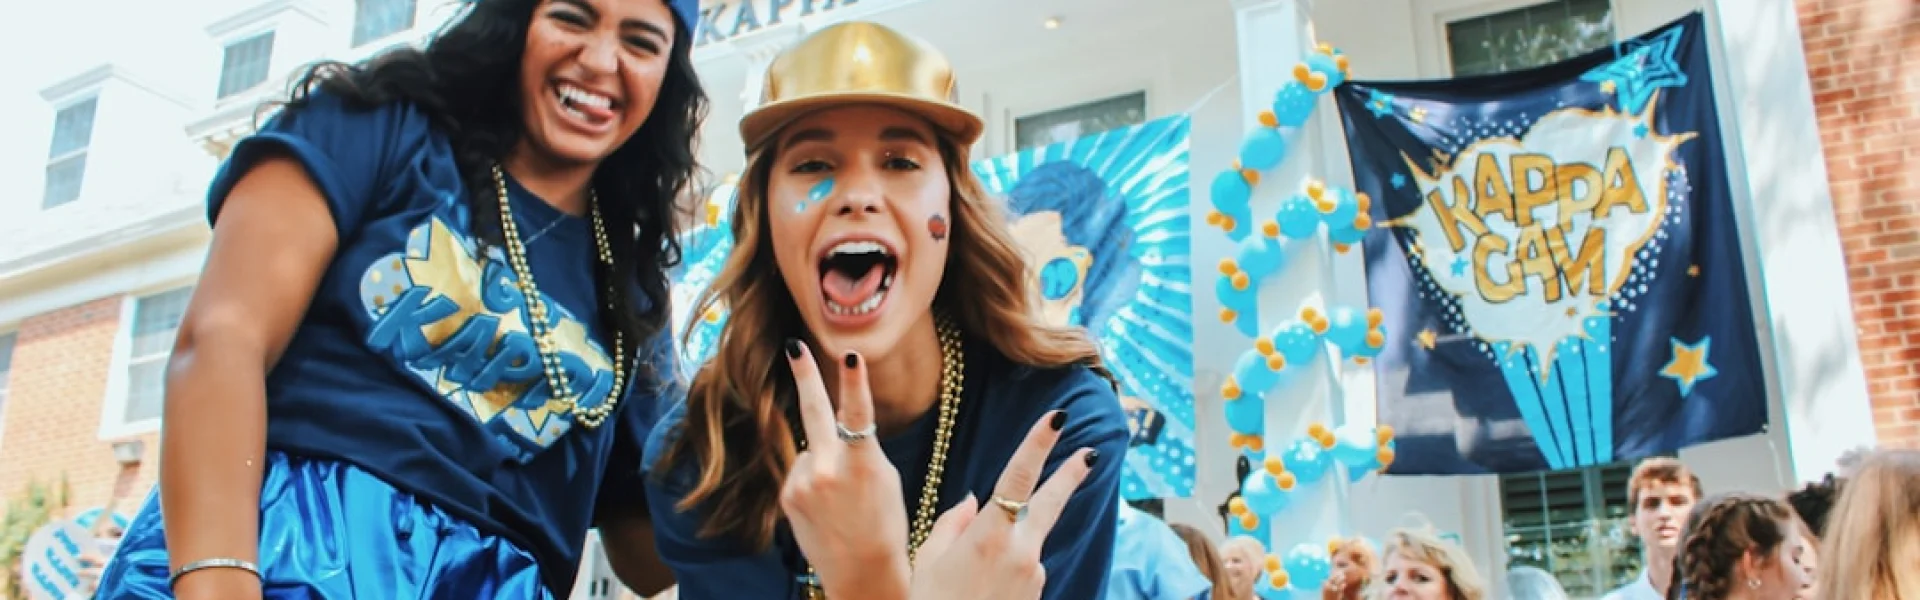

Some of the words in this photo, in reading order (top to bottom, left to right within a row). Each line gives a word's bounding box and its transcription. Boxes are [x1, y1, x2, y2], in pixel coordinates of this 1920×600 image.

[695, 0, 859, 47] KAP
[1427, 146, 1649, 253] KAPPA
[1473, 221, 1607, 304] GAM
